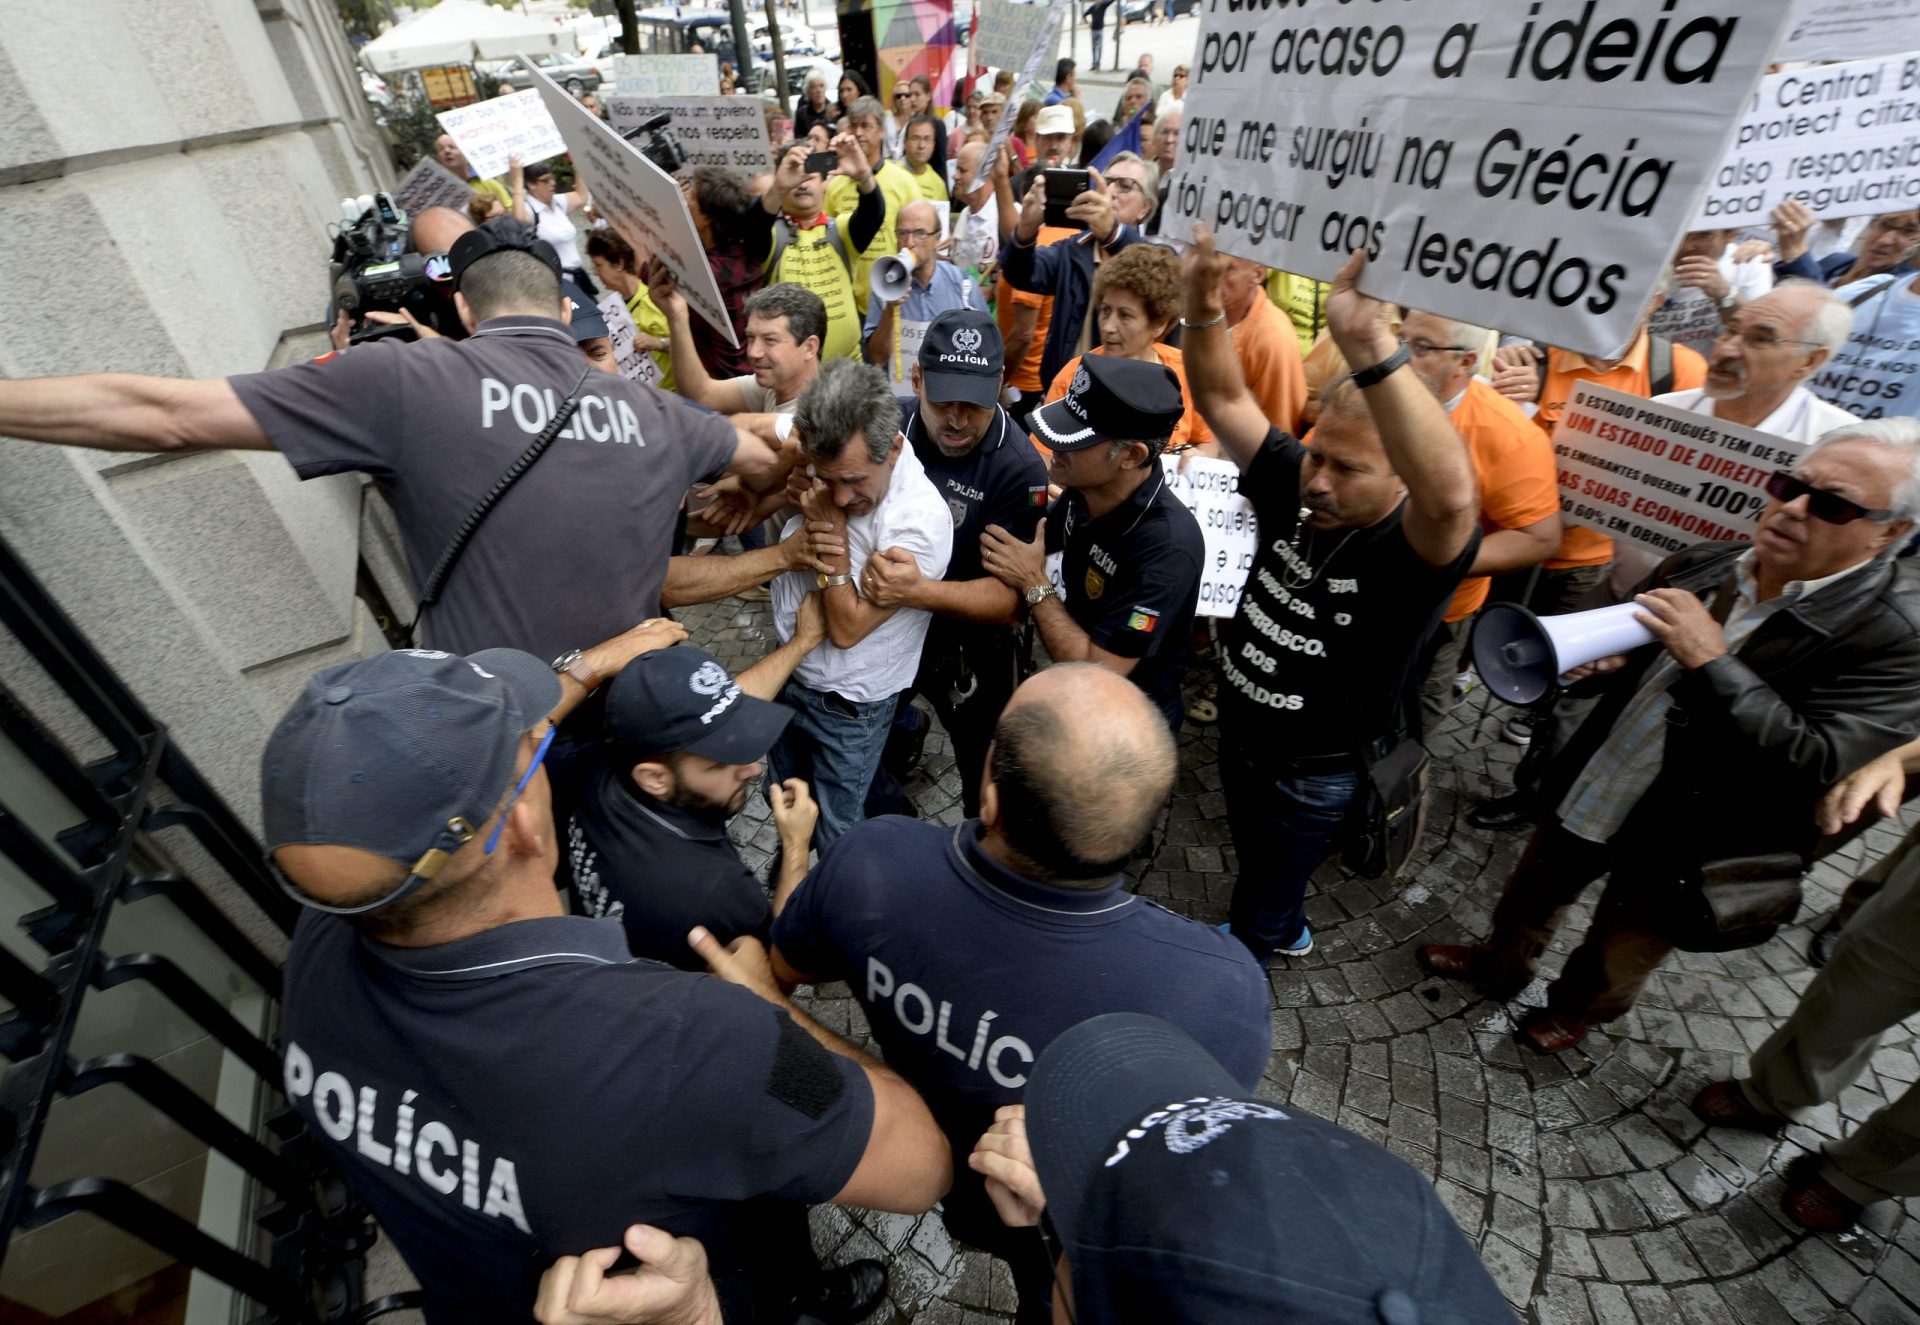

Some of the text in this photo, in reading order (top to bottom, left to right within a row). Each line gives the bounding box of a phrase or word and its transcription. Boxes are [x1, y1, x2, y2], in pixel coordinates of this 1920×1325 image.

[1198, 29, 1257, 83] por
[1272, 24, 1405, 77] acaso
[1433, 22, 1479, 80] a
[1505, 0, 1741, 85] ideia
[1777, 63, 1885, 108] Central
[1736, 106, 1841, 150] protect
[1185, 116, 1678, 218] que me surgiu na Grécia
[1717, 157, 1772, 188] also
[1704, 189, 1766, 217] bad
[1176, 172, 1627, 315] foi pagar aos lesados
[940, 353, 989, 367] POLÍCIA
[1586, 395, 1634, 419] ESTADO
[1637, 409, 1717, 444] PORTUGUÊS
[1718, 433, 1750, 454] TEM
[1751, 444, 1775, 460] DE
[1565, 411, 1772, 490] UM ESTADO DE DIREIT
[946, 478, 985, 502] POLÍCIA
[1557, 468, 1581, 490] AS
[1582, 479, 1632, 508] SUAS
[1570, 450, 1641, 481] EMIGRANTES
[1641, 473, 1692, 498] QUEREM
[1696, 481, 1768, 522] 100%
[1574, 503, 1606, 526] 60%
[1606, 516, 1631, 534] EM
[1088, 543, 1118, 577] POLÍCIA
[1241, 641, 1278, 674] DOS
[866, 955, 1035, 1090] POLÍC
[283, 1040, 534, 1236] POLÍCIA
